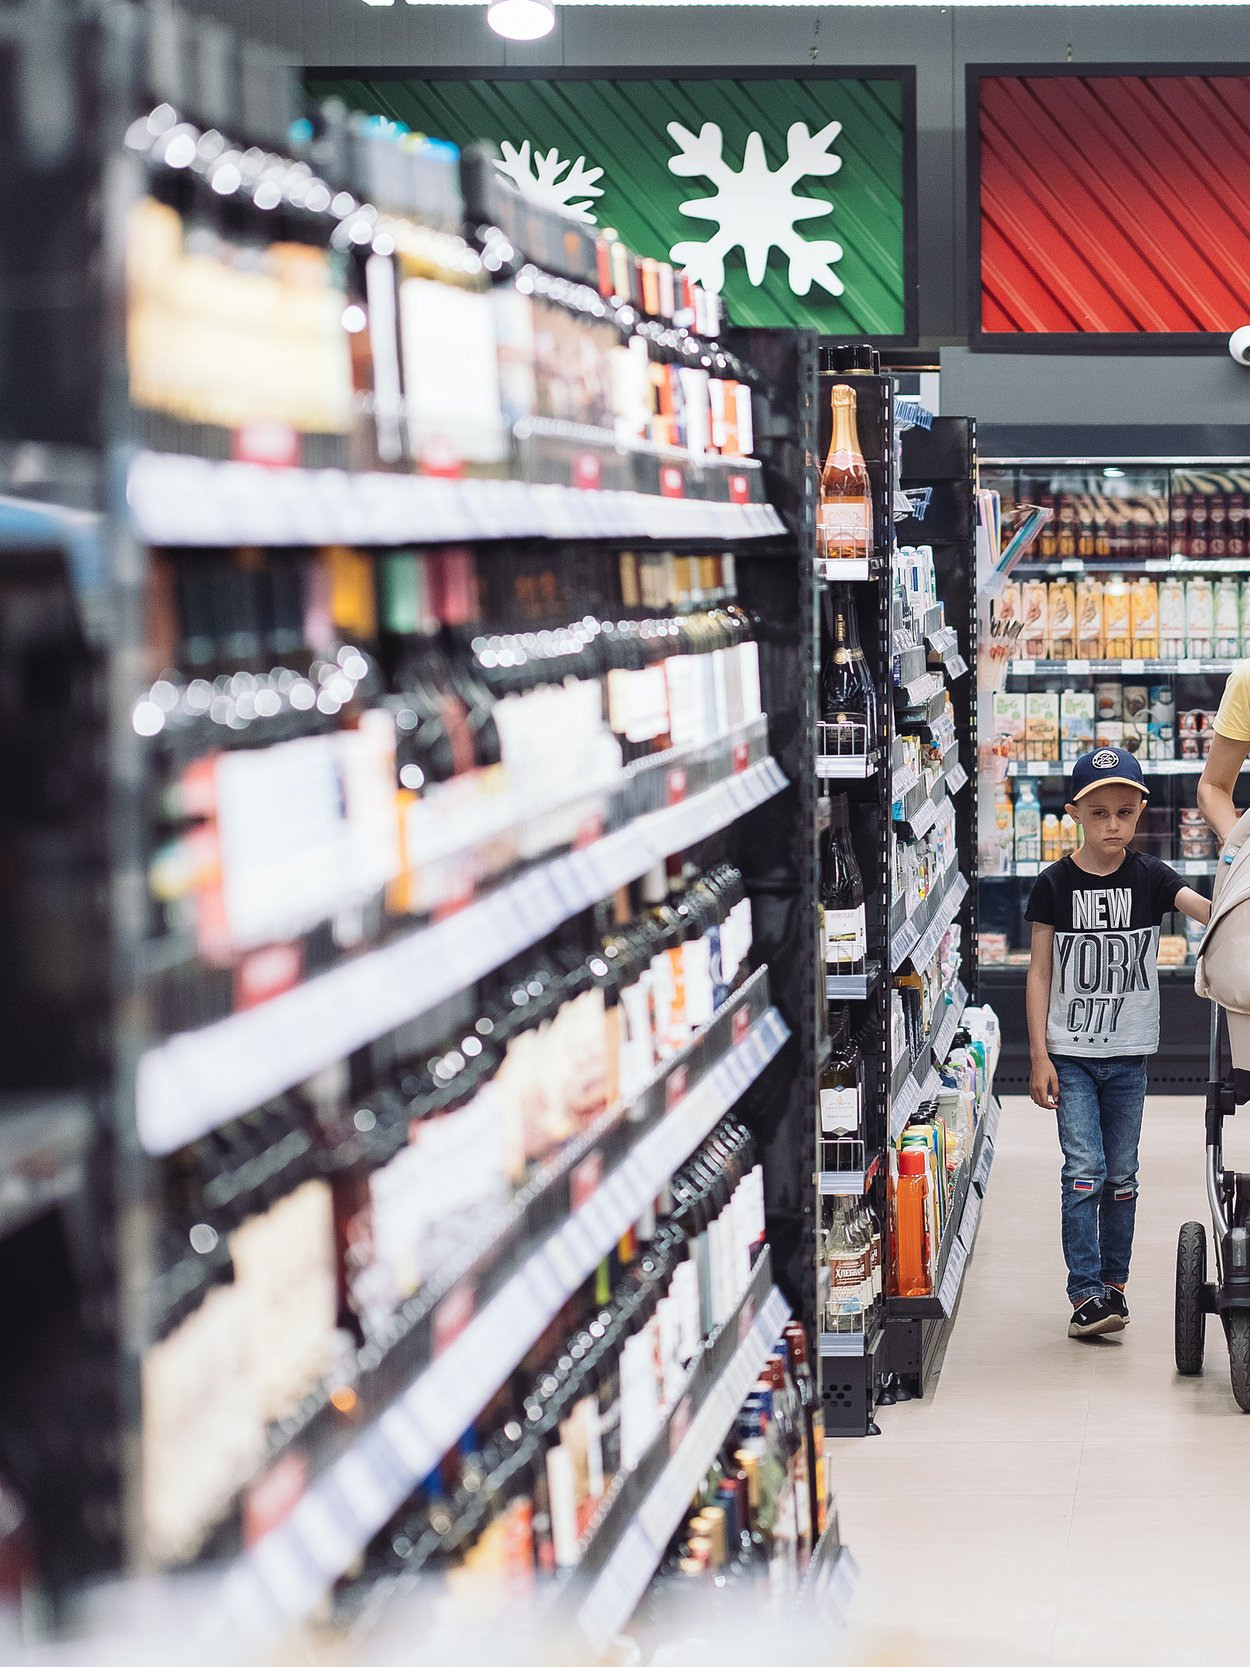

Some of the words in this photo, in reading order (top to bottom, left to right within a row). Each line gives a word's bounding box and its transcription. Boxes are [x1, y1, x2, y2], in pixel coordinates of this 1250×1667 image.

[1072, 888, 1132, 929] NEW
[1055, 929, 1152, 994] YORK
[1066, 997, 1125, 1033] CITY
